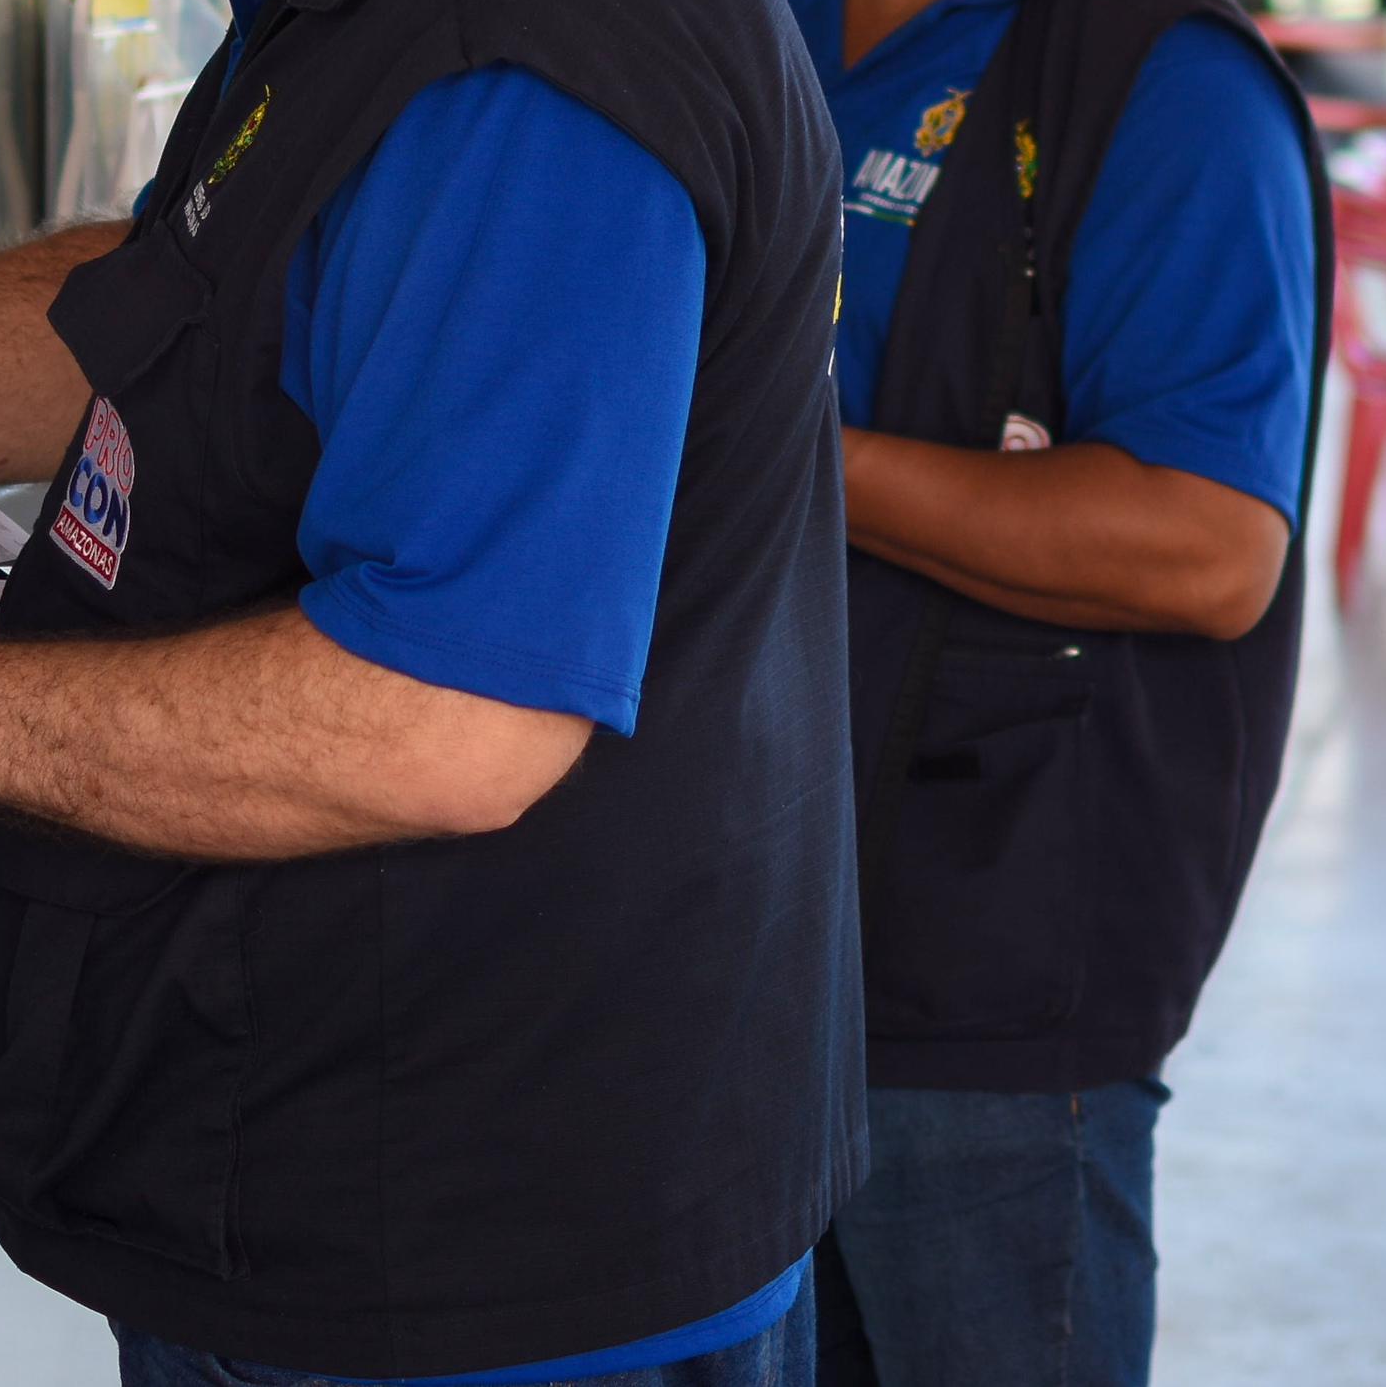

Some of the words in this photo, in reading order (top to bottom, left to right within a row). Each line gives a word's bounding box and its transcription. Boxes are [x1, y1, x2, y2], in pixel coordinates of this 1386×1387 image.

[85, 397, 134, 494] PRO
[56, 513, 114, 576] AMAZONAS
[69, 456, 128, 548] CON
